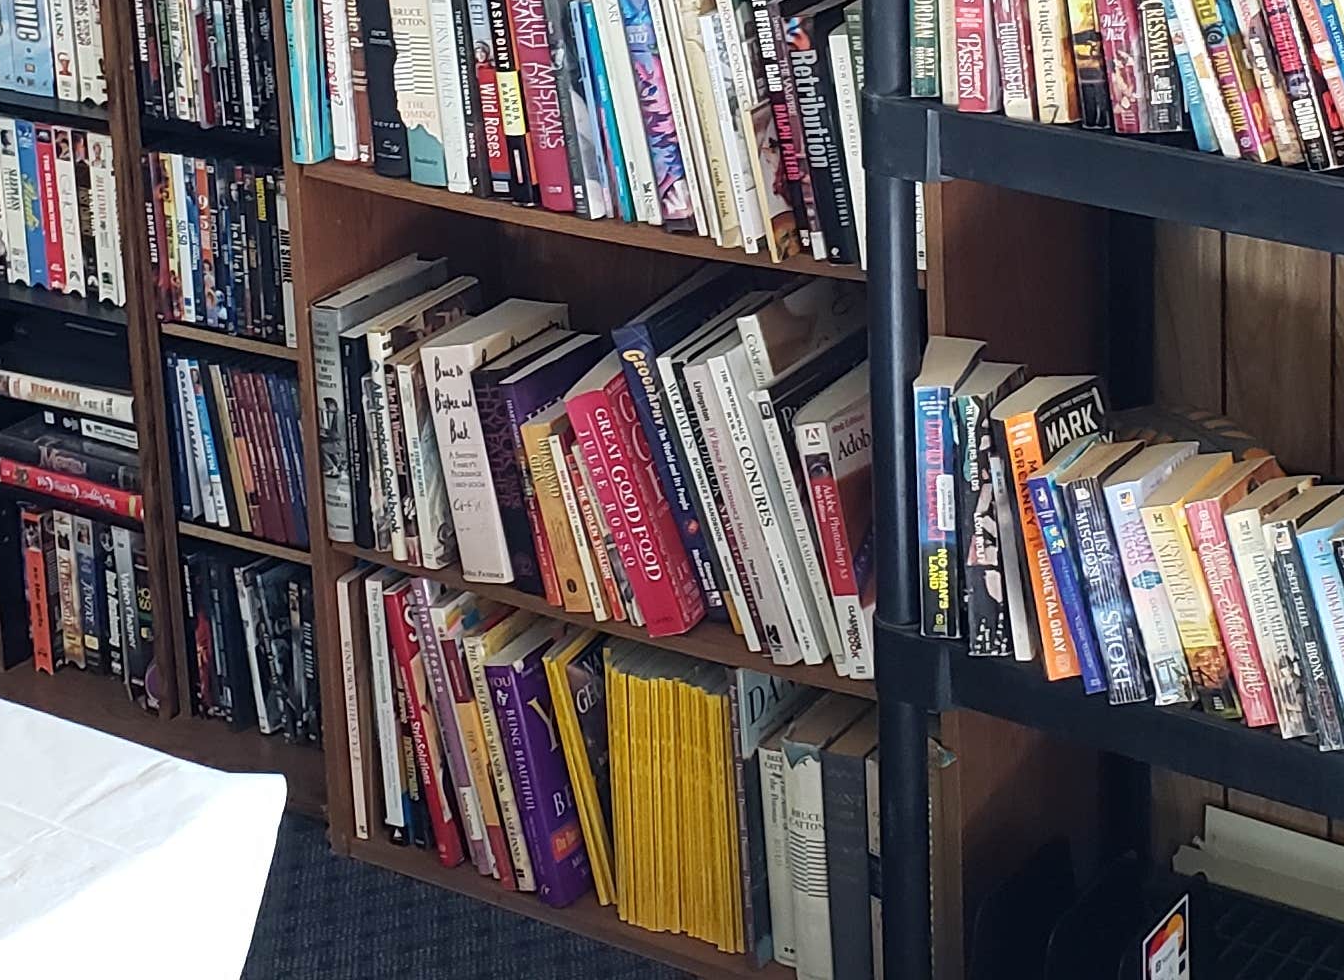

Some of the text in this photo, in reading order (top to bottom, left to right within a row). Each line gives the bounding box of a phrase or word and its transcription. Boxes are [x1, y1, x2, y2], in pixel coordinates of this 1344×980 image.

[393, 8, 423, 17] BRUCE
[1147, 0, 1170, 74] CRESSWELL
[763, 62, 783, 93] CLUB
[924, 47, 935, 77] MATT
[1212, 52, 1248, 133] PAUL THEROUX
[479, 82, 500, 158] Wild Roses
[772, 104, 801, 182] RALPH PETERS
[789, 49, 828, 169] Retribution
[1292, 99, 1320, 141] CONGO
[622, 349, 664, 423] GEOGRAPHY
[1045, 407, 1098, 449] MARK
[578, 430, 636, 568] JULEE ROSSO
[594, 408, 662, 581] GREAT GOOD FOOD
[739, 445, 775, 529] CONURES
[1014, 446, 1035, 525] GREANEY
[927, 555, 938, 589] LAND
[937, 548, 949, 609] NO MAN'S
[1075, 512, 1101, 586] MISCIONE
[1092, 530, 1112, 563] LISA
[1036, 549, 1067, 653] GUNMETAL GRAY
[1099, 609, 1132, 694] SMOKE
[1305, 641, 1325, 681] BRONX
[506, 709, 536, 811] BEING BEAUTIFUL
